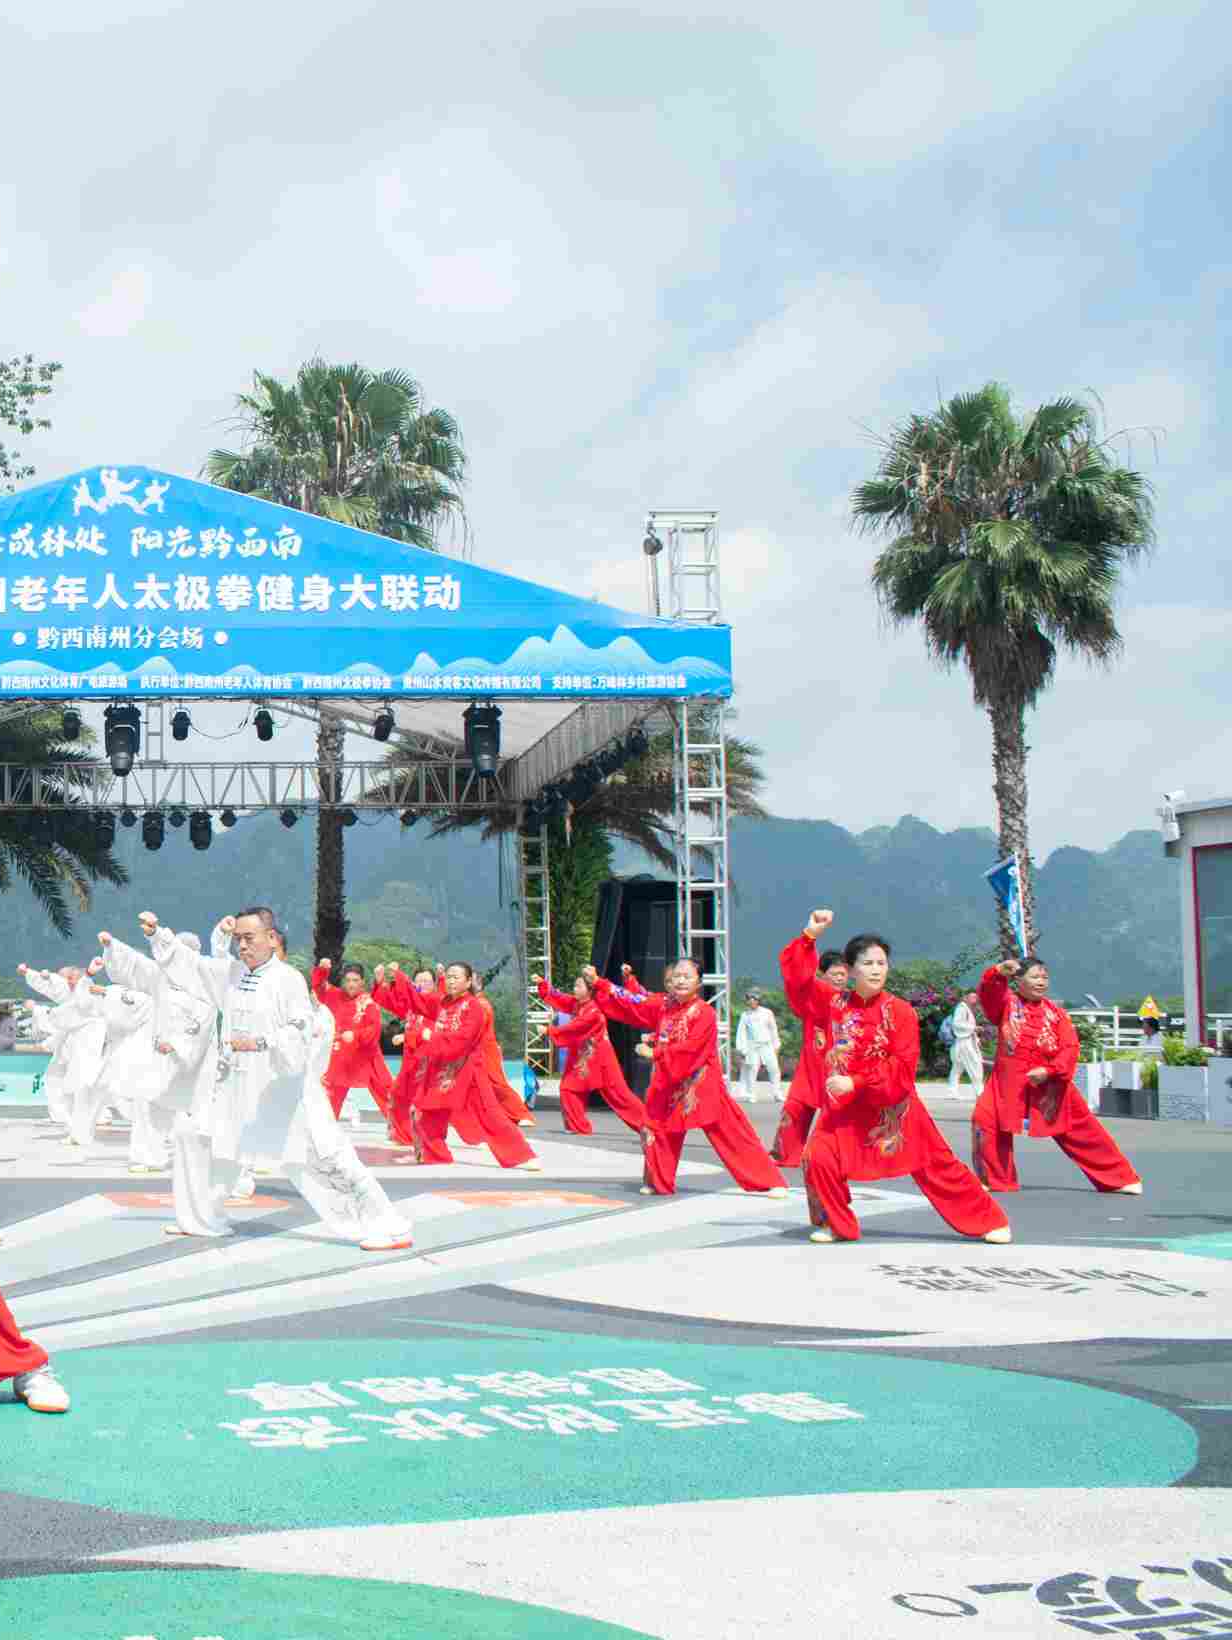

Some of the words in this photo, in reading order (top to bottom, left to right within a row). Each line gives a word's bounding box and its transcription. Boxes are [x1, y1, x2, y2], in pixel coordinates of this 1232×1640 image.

[130, 525, 303, 560] 阳光黔西南
[35, 626, 205, 650] 黔西南州分会场
